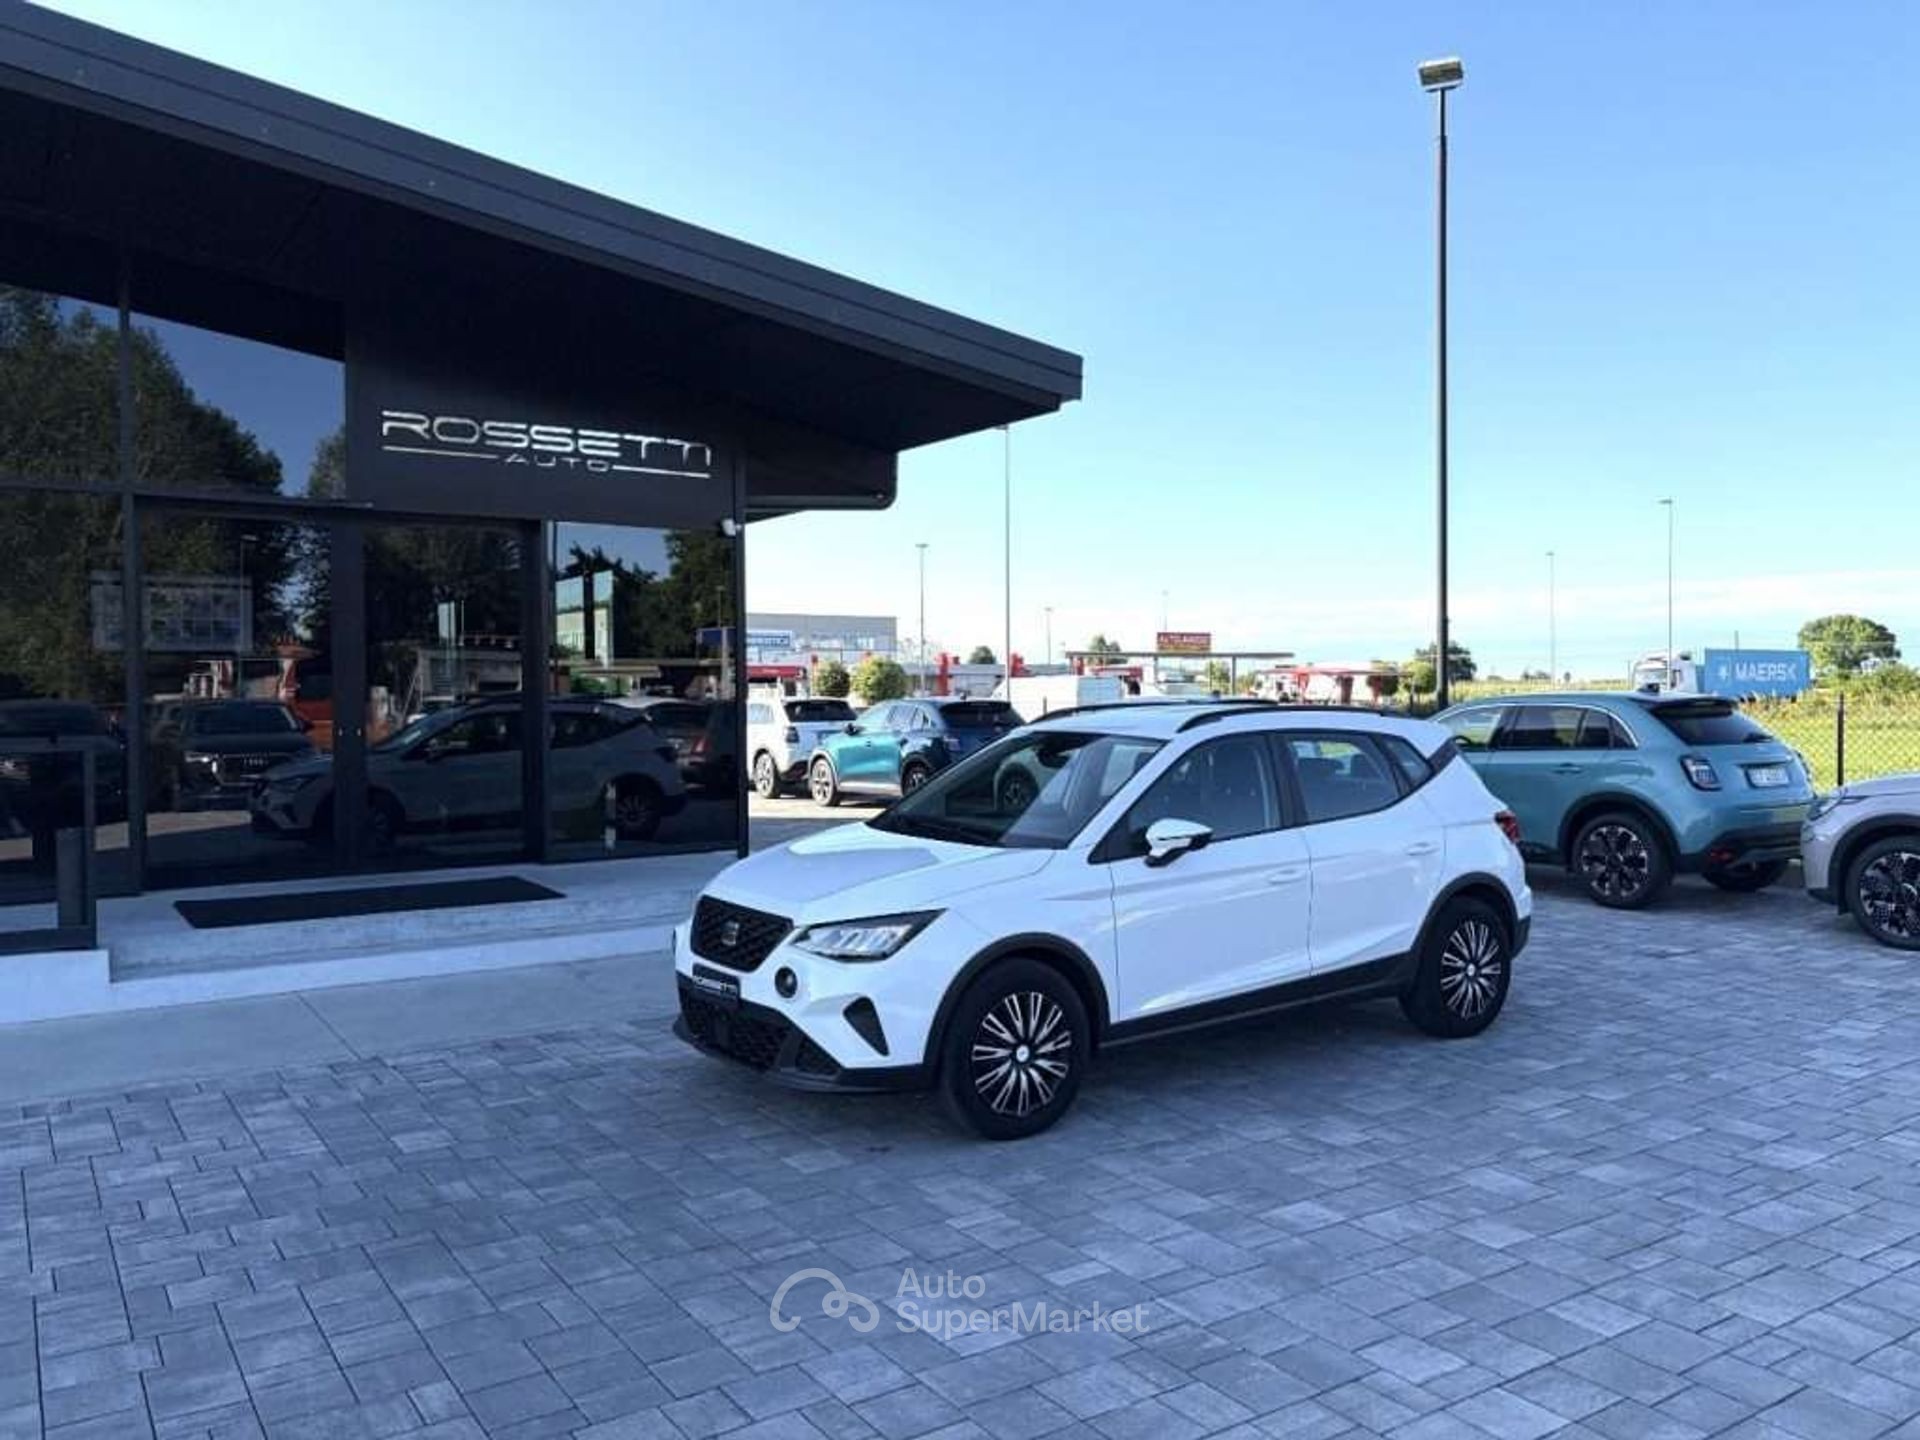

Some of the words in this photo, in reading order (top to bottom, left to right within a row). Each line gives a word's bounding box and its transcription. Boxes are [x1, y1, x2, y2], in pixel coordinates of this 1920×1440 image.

[382, 410, 711, 467] ROSSETTI
[504, 453, 609, 472] AUTO
[1735, 661, 1798, 681] MAERSK
